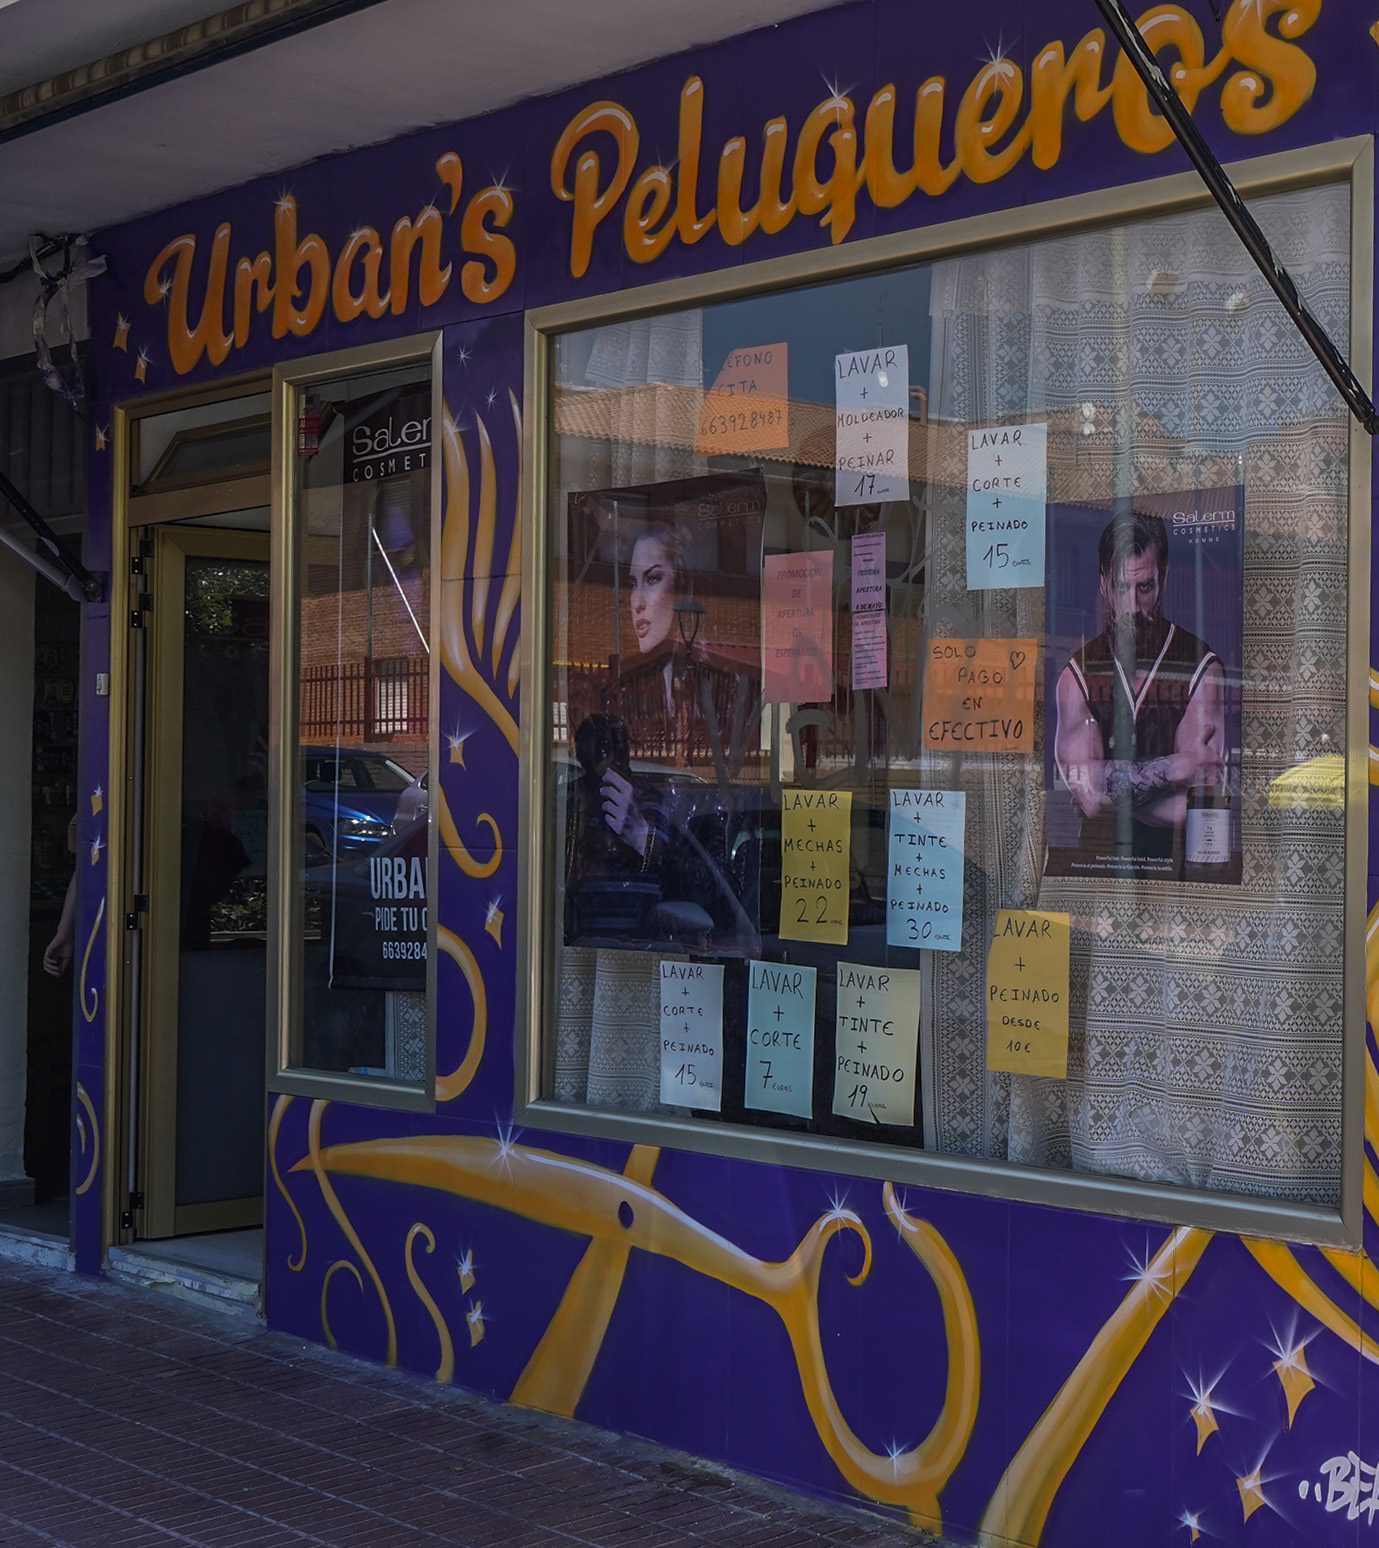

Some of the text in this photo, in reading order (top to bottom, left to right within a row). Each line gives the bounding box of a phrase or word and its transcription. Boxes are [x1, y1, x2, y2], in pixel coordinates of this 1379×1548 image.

[144, 0, 1322, 375] Urban's Peluqueros
[838, 350, 898, 379] LAVAR
[718, 380, 757, 397] CITA
[701, 410, 782, 436] 663928487
[838, 407, 904, 428] MOLDEADOR
[971, 429, 1022, 450] LAVAR
[839, 450, 896, 471] PEINAR
[855, 474, 876, 497] 17
[973, 477, 1021, 492] CORTE
[971, 520, 1028, 532] PEINADO
[1173, 510, 1235, 524] Salerm
[1173, 524, 1235, 535] COSMETICS
[983, 543, 1009, 568] 15
[792, 588, 802, 598] DE
[933, 645, 976, 660] SOLO
[958, 667, 1003, 684] PAGO
[962, 697, 983, 711] EN
[929, 719, 1024, 741] EFECTIVO
[784, 793, 839, 811] LAVAR
[893, 791, 945, 808] LAVAR
[784, 838, 843, 853] MECHAS
[894, 834, 947, 848] TINTE
[370, 857, 428, 899] URBA
[894, 864, 946, 880] MECHAS
[784, 875, 842, 890] PEINADO
[796, 896, 828, 924] 22
[891, 899, 949, 913] PEINADO
[375, 907, 398, 931] PIDE
[403, 907, 418, 931] TU
[907, 918, 932, 940] 30
[662, 964, 704, 980] LAVAR
[752, 972, 803, 999] LAVAR
[839, 973, 890, 992] LAVAR
[990, 985, 1060, 1003] PEINADO
[663, 1005, 703, 1016] CORTE
[839, 1016, 894, 1036] TINTE
[1002, 1016, 1040, 1030] DESDE
[663, 1040, 714, 1056] PEINADO
[750, 1029, 801, 1050] CORTE
[675, 1064, 696, 1085] 15
[759, 1061, 773, 1089] 7
[838, 1056, 905, 1083] PEINADO
[848, 1084, 868, 1108] 19
